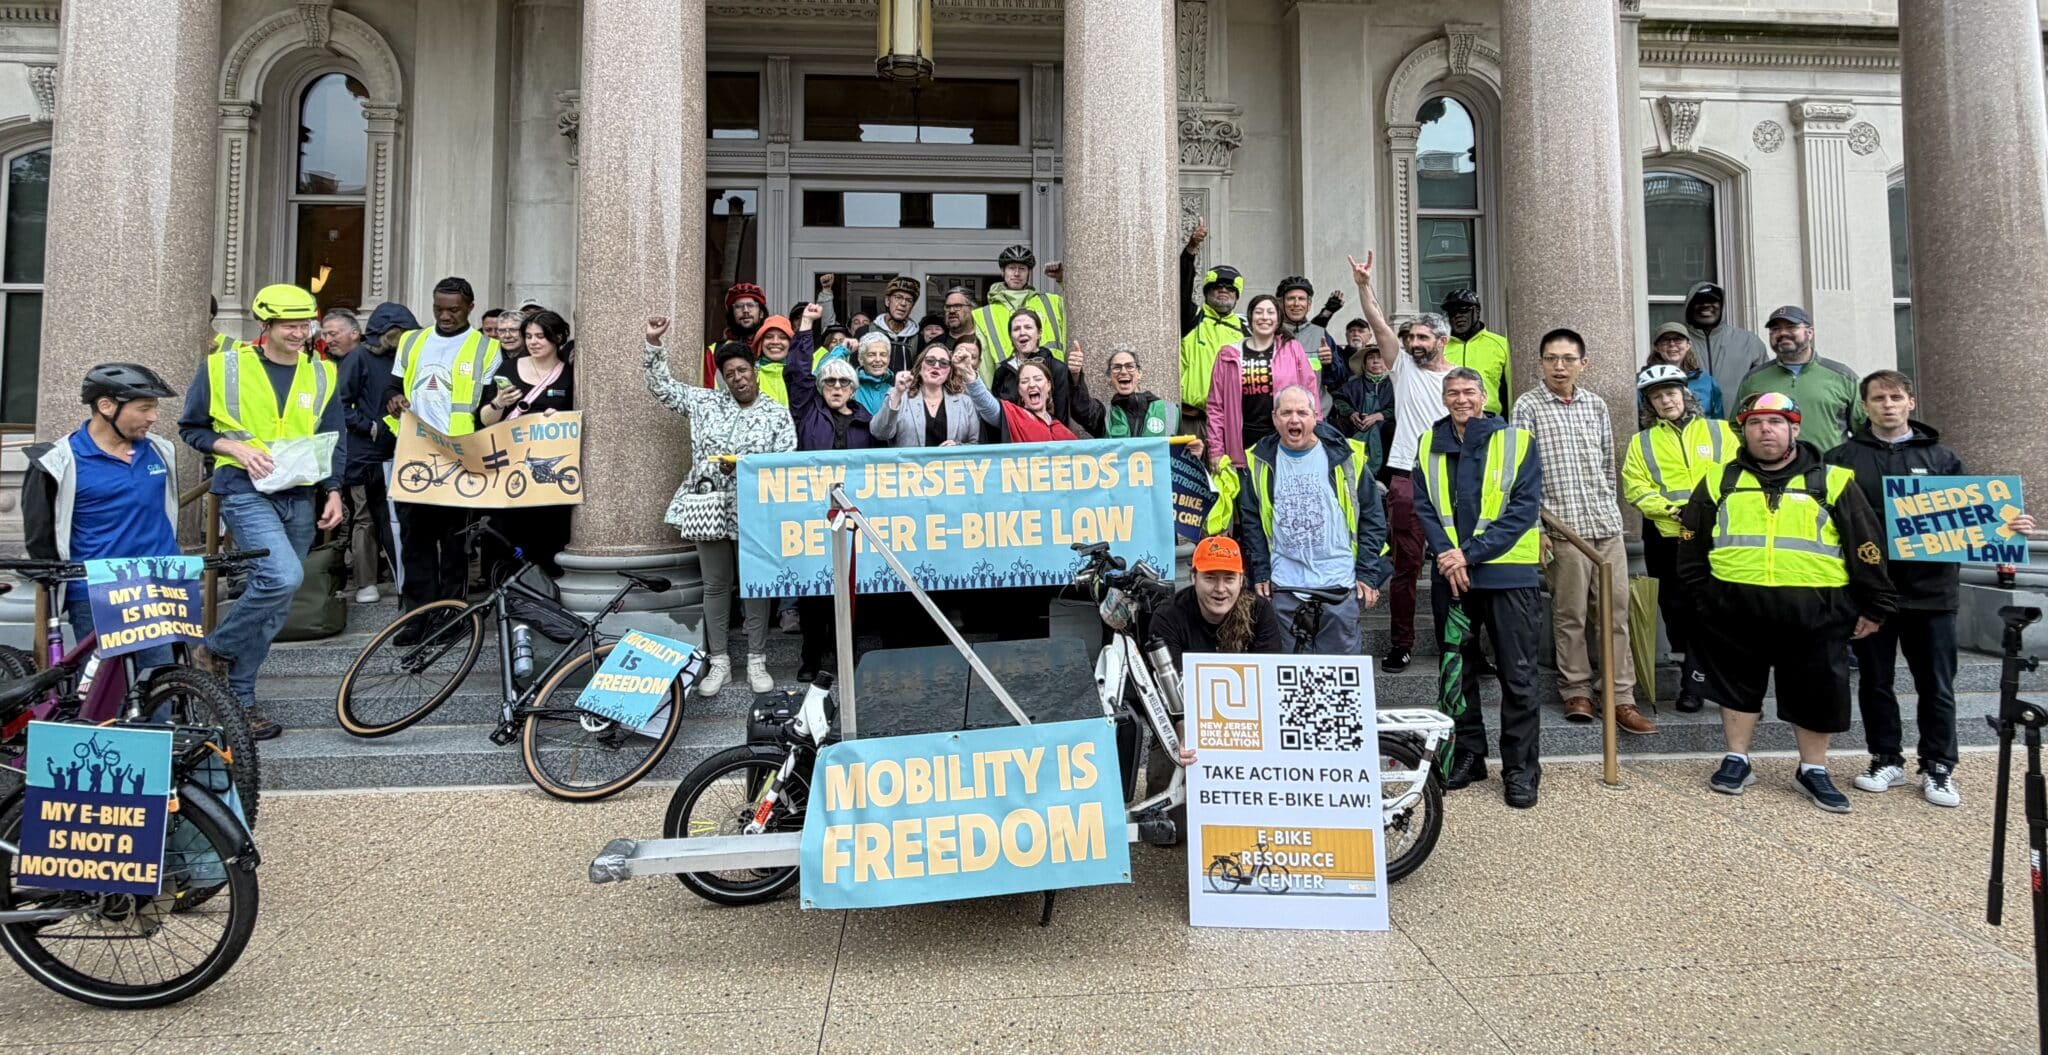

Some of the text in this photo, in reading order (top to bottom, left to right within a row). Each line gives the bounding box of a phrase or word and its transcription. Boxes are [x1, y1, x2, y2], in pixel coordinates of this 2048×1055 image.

[511, 422, 579, 443] E-MOTO
[758, 451, 1153, 503] NEW JERSEY NEEDS A
[1886, 478, 1920, 497] NJ
[1179, 494, 1203, 511] BIKE,
[1893, 480, 2012, 517] NEEDS A
[1179, 511, 1202, 527] CAR!
[1895, 504, 1999, 537] BETTER
[781, 505, 1134, 557] BETER E-BIKE LAW
[1894, 526, 1988, 558] E-BIKE
[1967, 544, 2025, 563] LAW
[109, 584, 189, 605] MY E-BIKE
[122, 602, 187, 623] IS NOT A
[100, 621, 204, 650] MOTORCYCLE
[623, 632, 686, 666] MOBILITY
[619, 650, 642, 671] is
[591, 673, 670, 695] FREEDOM
[1200, 722, 1259, 730] NEW JERSEY
[1201, 738, 1260, 747] COALITION
[825, 741, 1098, 811] MOBILITY IS
[1202, 765, 1244, 780] TAKE
[1250, 766, 1314, 782] ACTION
[1320, 768, 1353, 782] FOR
[1358, 769, 1370, 783] A
[1200, 790, 1371, 808] BETTER E-BIKE LAW!
[41, 800, 146, 827] MY E-BIKE
[48, 829, 133, 854] IS NOT A
[821, 801, 1107, 885] FREEDOM
[1257, 830, 1312, 845] E-BIKE
[20, 854, 158, 883] MOTORCYCLE
[1241, 851, 1334, 868] RESOURCE
[1258, 873, 1325, 890] CENTER
